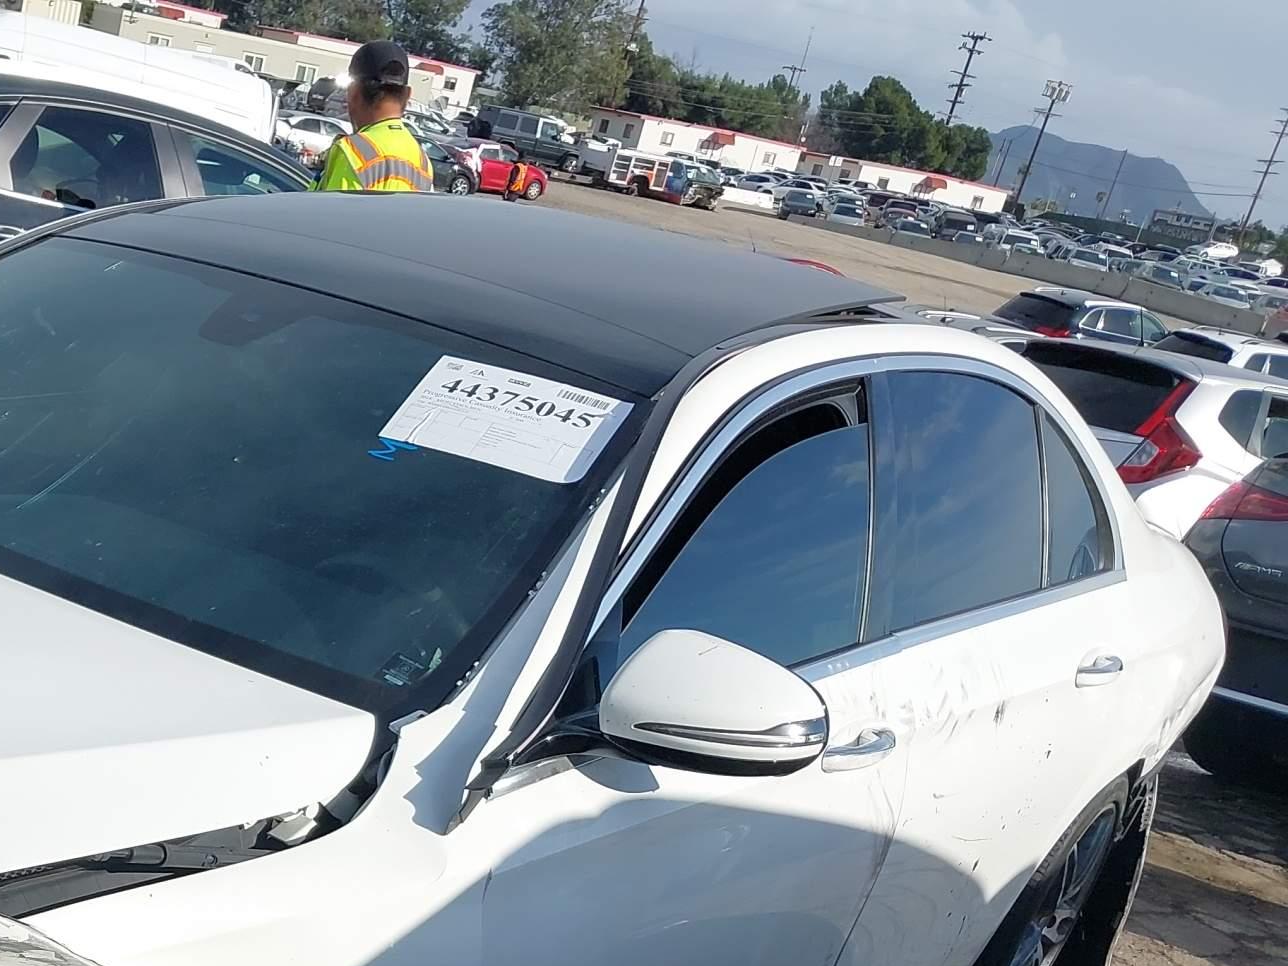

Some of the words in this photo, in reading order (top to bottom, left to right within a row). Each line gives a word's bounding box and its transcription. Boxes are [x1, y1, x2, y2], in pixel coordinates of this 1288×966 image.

[423, 388, 466, 404] Progressive
[469, 398, 501, 412] Casualty
[504, 407, 542, 422] Insurance
[441, 378, 599, 428] 44375045
